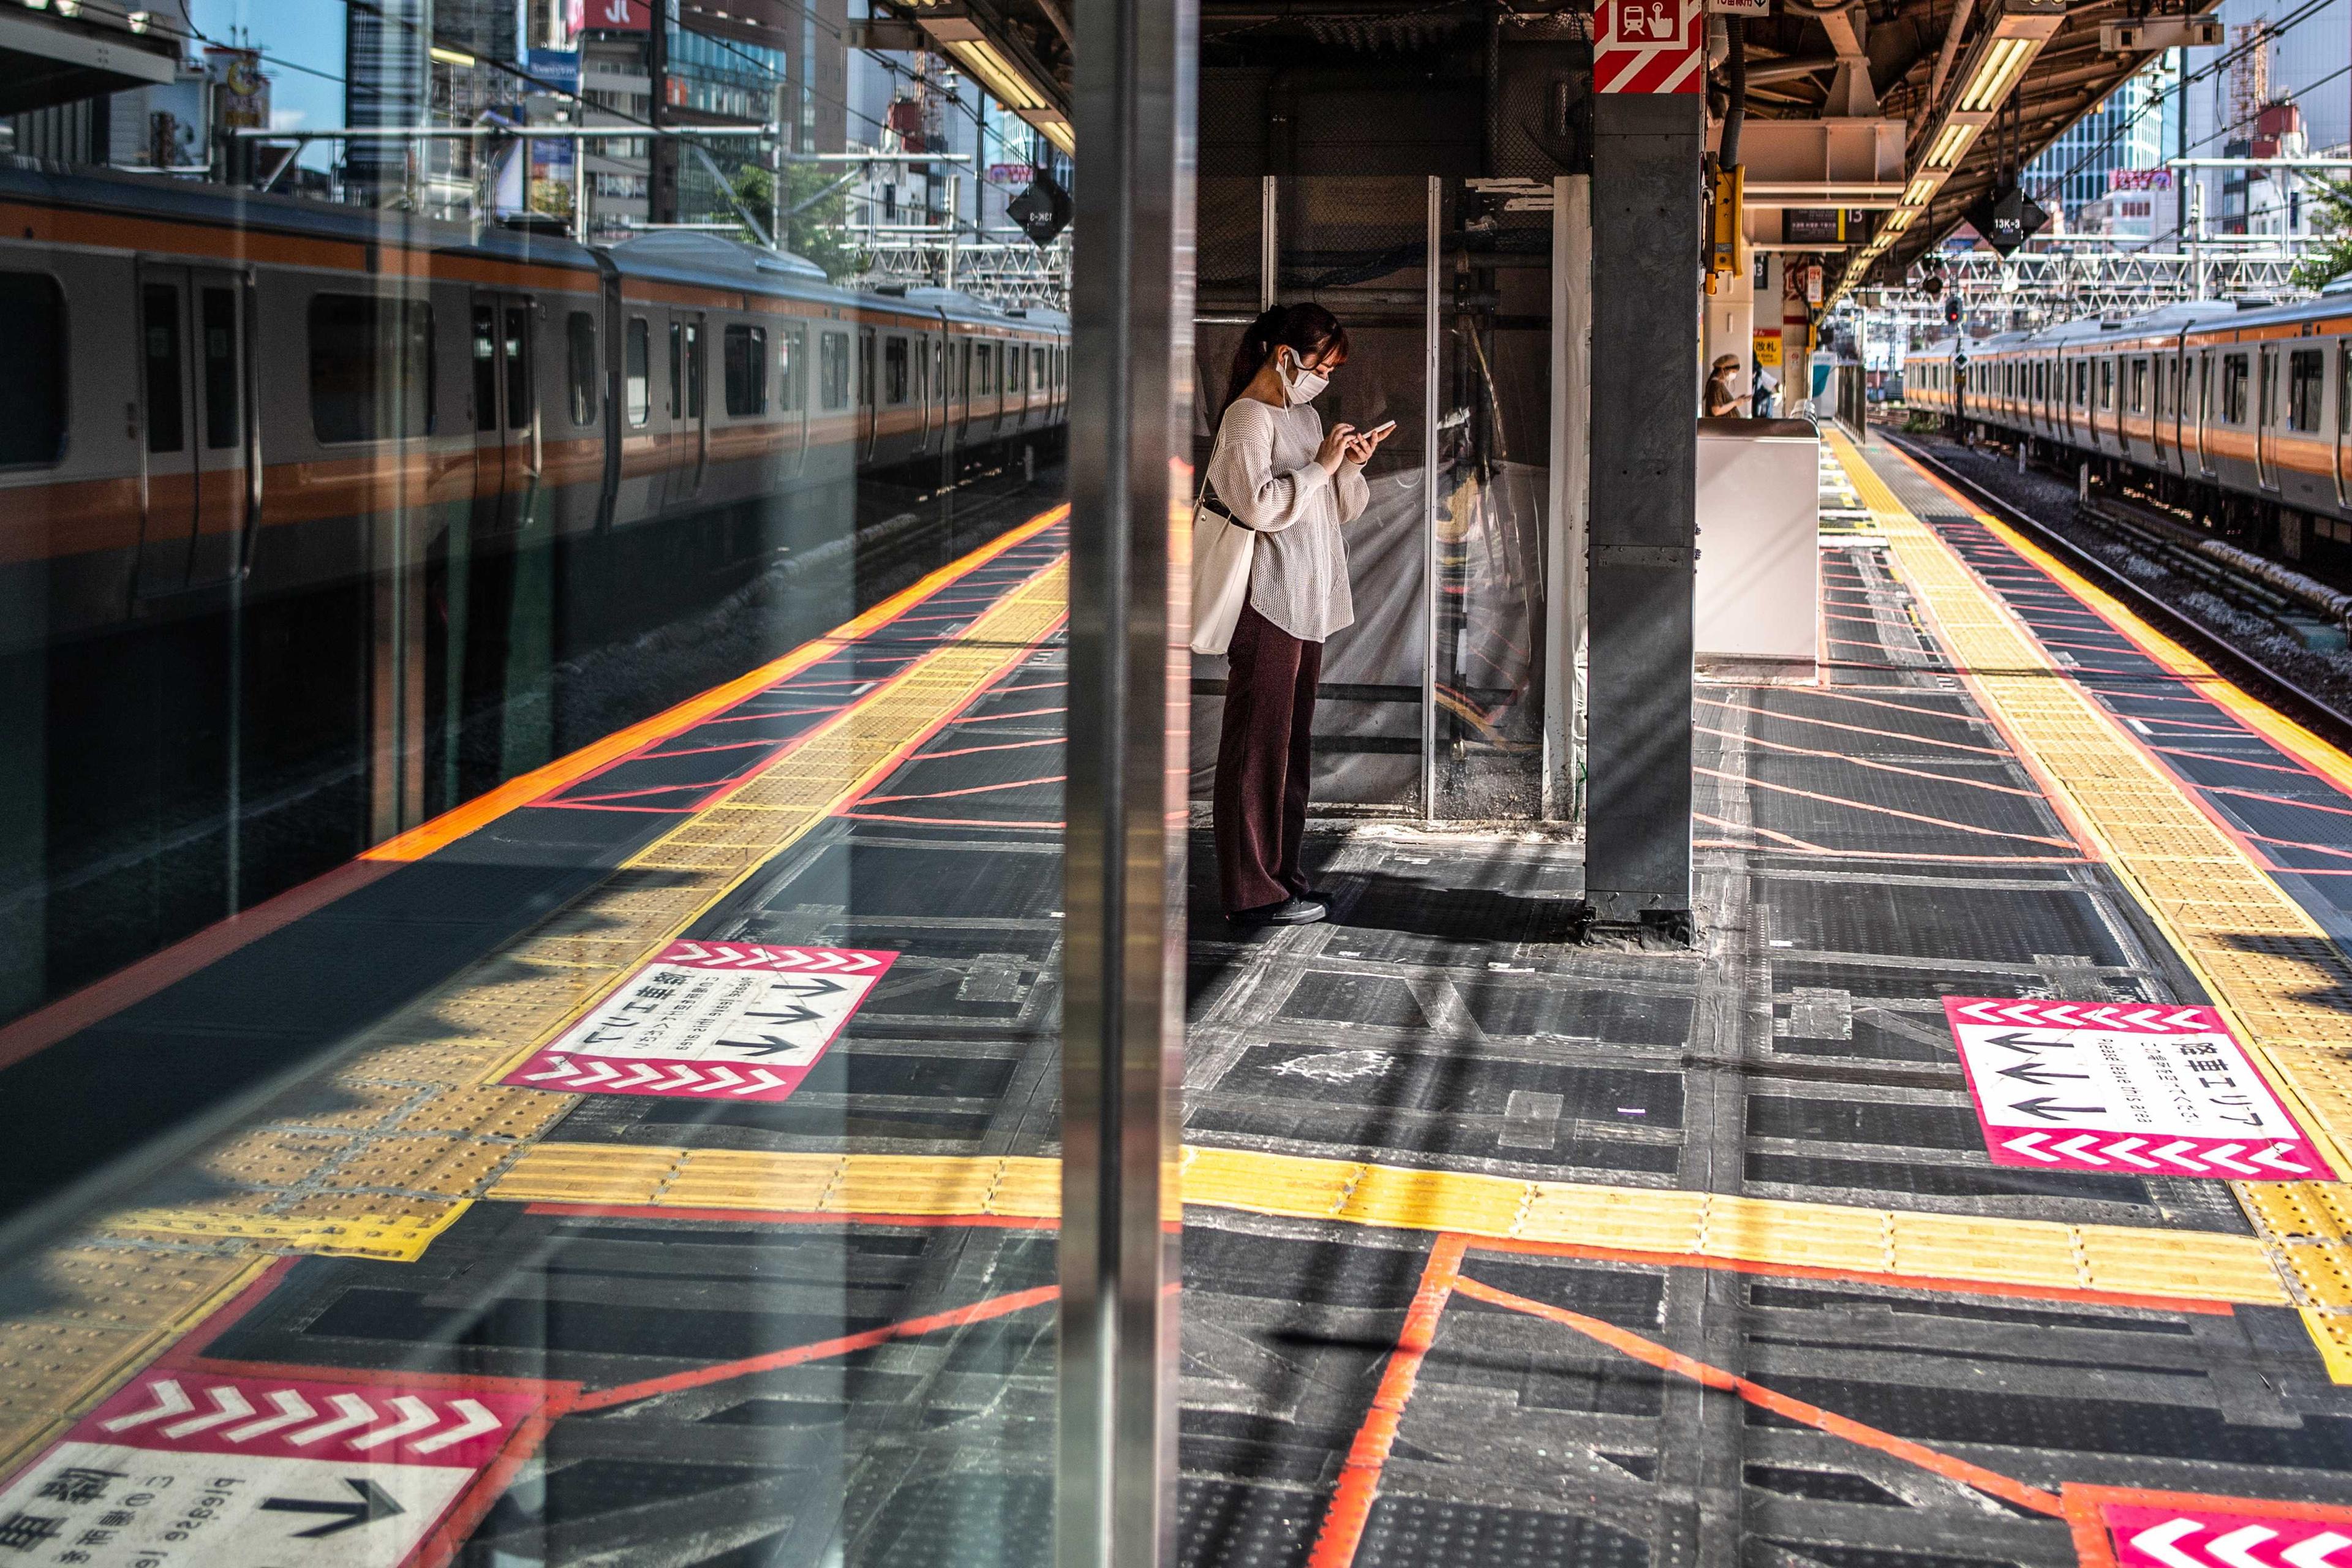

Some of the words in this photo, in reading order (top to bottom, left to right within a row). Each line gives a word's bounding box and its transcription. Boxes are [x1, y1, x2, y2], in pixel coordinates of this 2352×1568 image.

[1849, 209, 1863, 223] 13
[1994, 218, 2020, 229] 13K-3
[2097, 1038, 2124, 1062] Please
[2108, 1063, 2132, 1084] leave
[2171, 1042, 2264, 1126] 降車エリア
[2120, 1086, 2144, 1102] this
[2130, 1104, 2152, 1123] area
